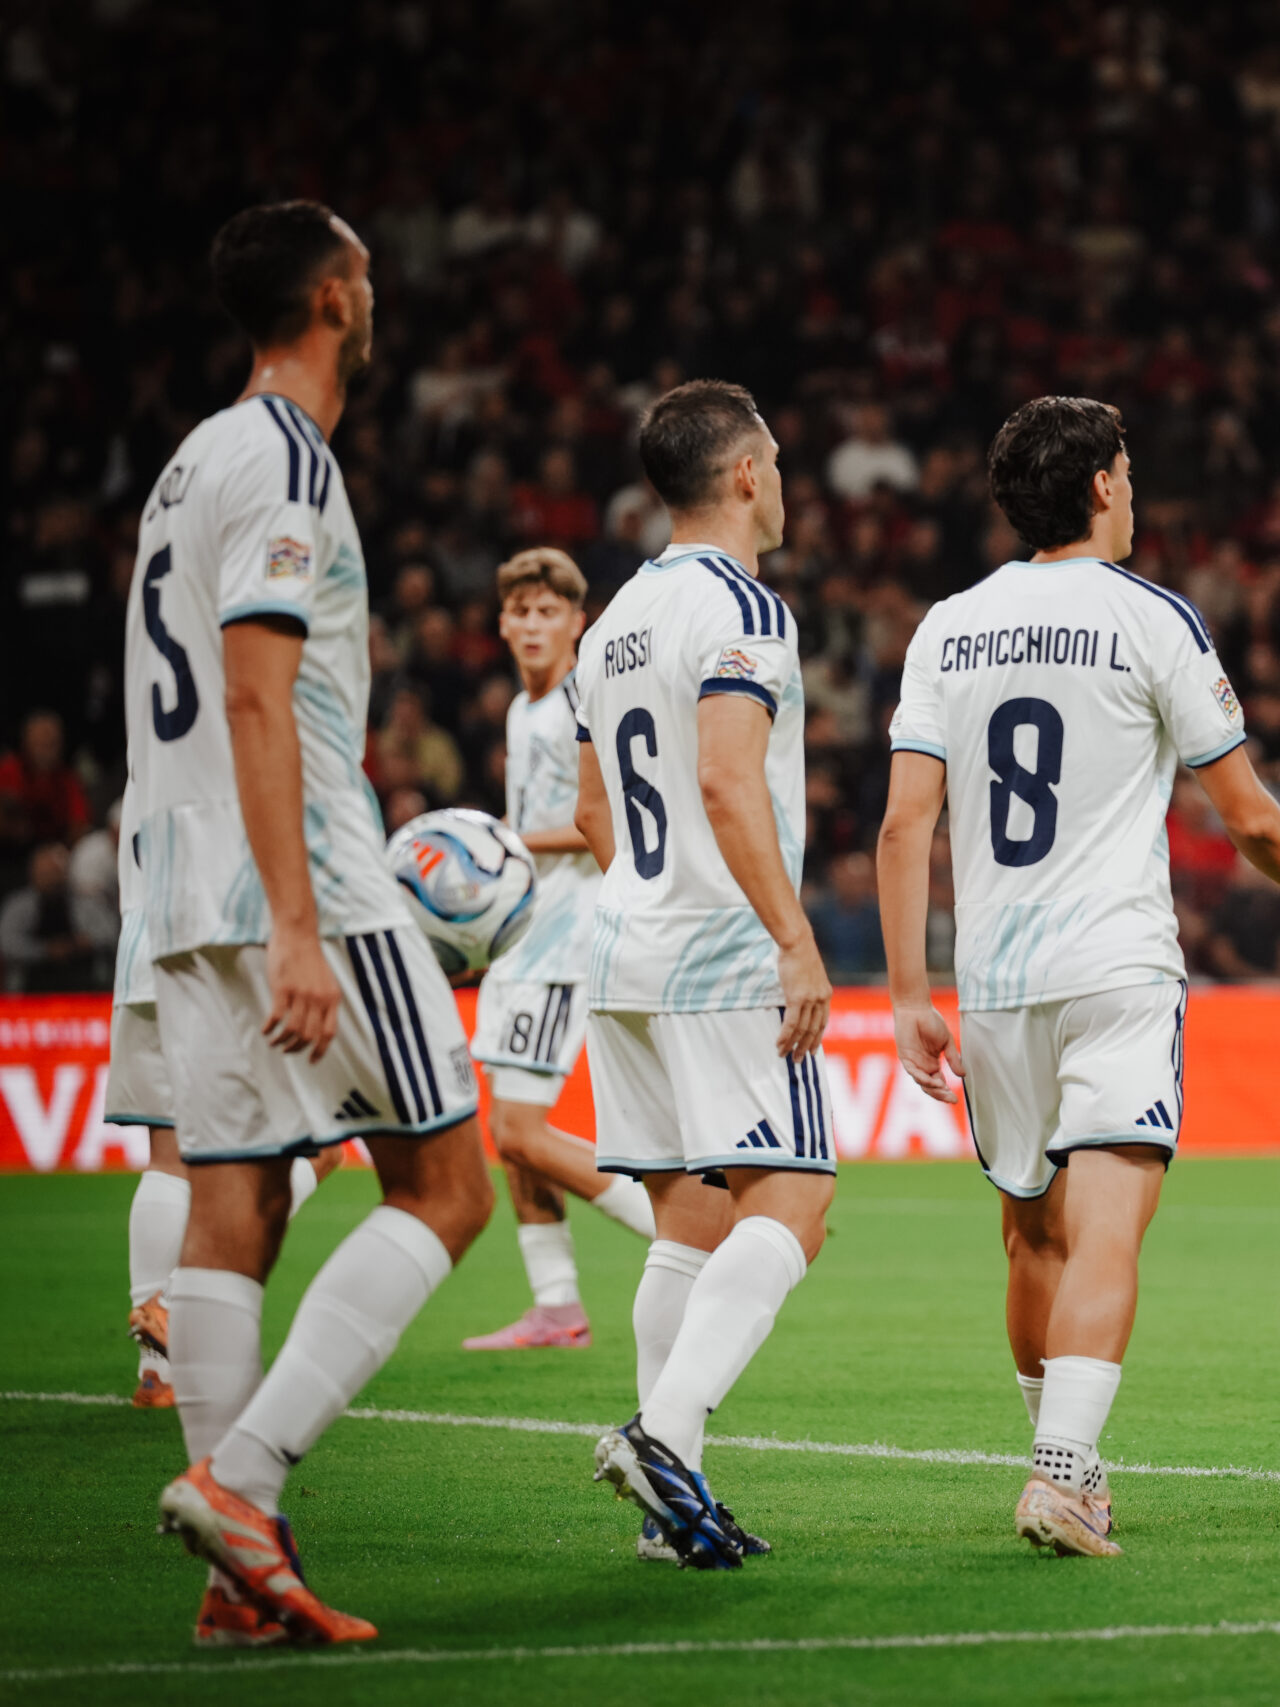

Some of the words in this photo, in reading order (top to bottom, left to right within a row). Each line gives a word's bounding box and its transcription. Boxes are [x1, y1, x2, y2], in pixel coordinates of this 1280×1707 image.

[143, 543, 199, 743] 5
[605, 625, 653, 679] ROSSI
[940, 625, 1099, 672] CAPICCHIONI
[1109, 632, 1131, 672] L.
[616, 707, 667, 880] 6
[988, 697, 1064, 868] 8
